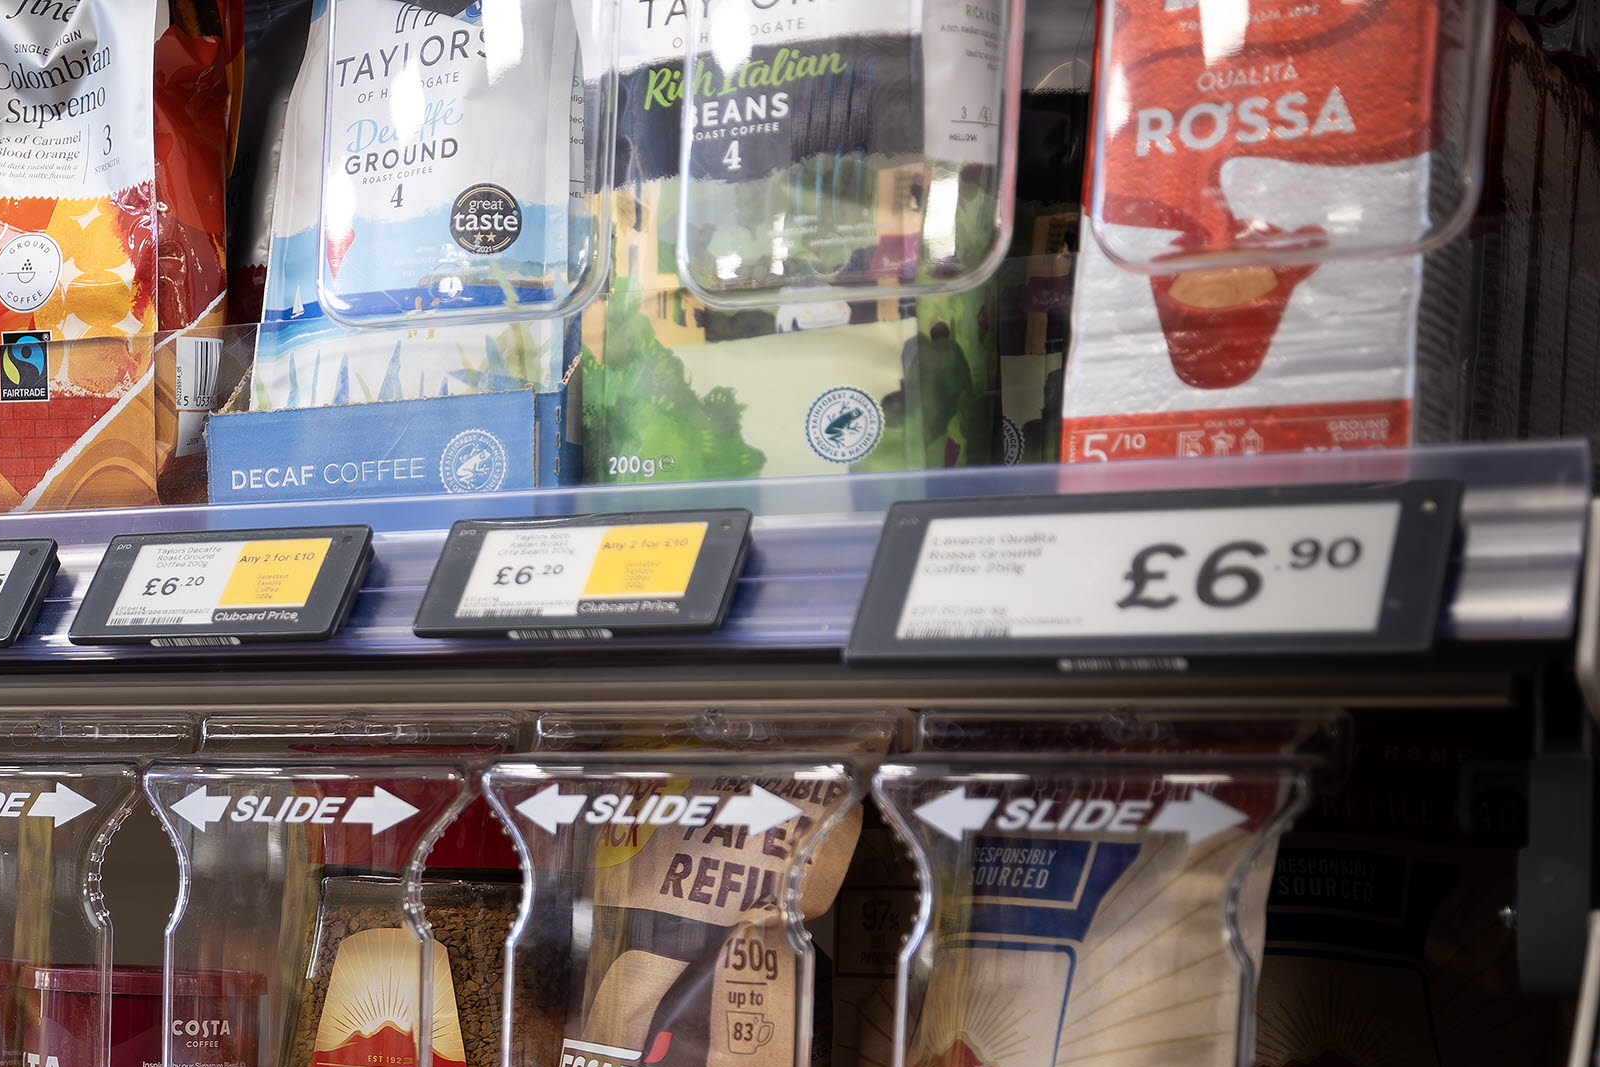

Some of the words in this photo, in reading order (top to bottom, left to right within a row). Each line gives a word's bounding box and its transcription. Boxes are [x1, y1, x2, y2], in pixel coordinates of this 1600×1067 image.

[5, 86, 106, 129] Supremo
[357, 90, 374, 104] OF
[683, 93, 789, 129] BEANS
[102, 124, 113, 156] 3
[344, 138, 459, 175] GROUND
[722, 140, 741, 171] 4
[362, 172, 394, 184] ROAST
[396, 166, 433, 180] COFFEE
[389, 184, 404, 208] 4
[468, 198, 504, 213] great
[453, 212, 519, 231] taste
[8, 239, 51, 256] GROUND
[6, 289, 44, 304] COFFEE
[2, 387, 46, 398] FAIRTRADE
[231, 465, 315, 490] DECAF
[323, 457, 425, 484] COFFEE
[609, 455, 655, 477] 200g
[239, 554, 262, 565] Any
[264, 554, 271, 562] 2
[273, 553, 291, 562] for
[294, 552, 314, 561] £10
[493, 564, 564, 585] £6.20
[1115, 536, 1364, 611] £6.90
[142, 576, 204, 596] £6.20
[215, 612, 266, 622] Clubcard
[267, 609, 298, 621] Price
[229, 796, 347, 826] SLIDE
[585, 794, 719, 825] SLIDE
[996, 799, 1154, 832] SLIDE
[968, 866, 1050, 890] SOURCED
[723, 938, 778, 980] 150g
[728, 989, 746, 1008] up
[750, 991, 764, 1005] to
[172, 1020, 230, 1038] COSTA
[733, 1022, 754, 1040] 83
